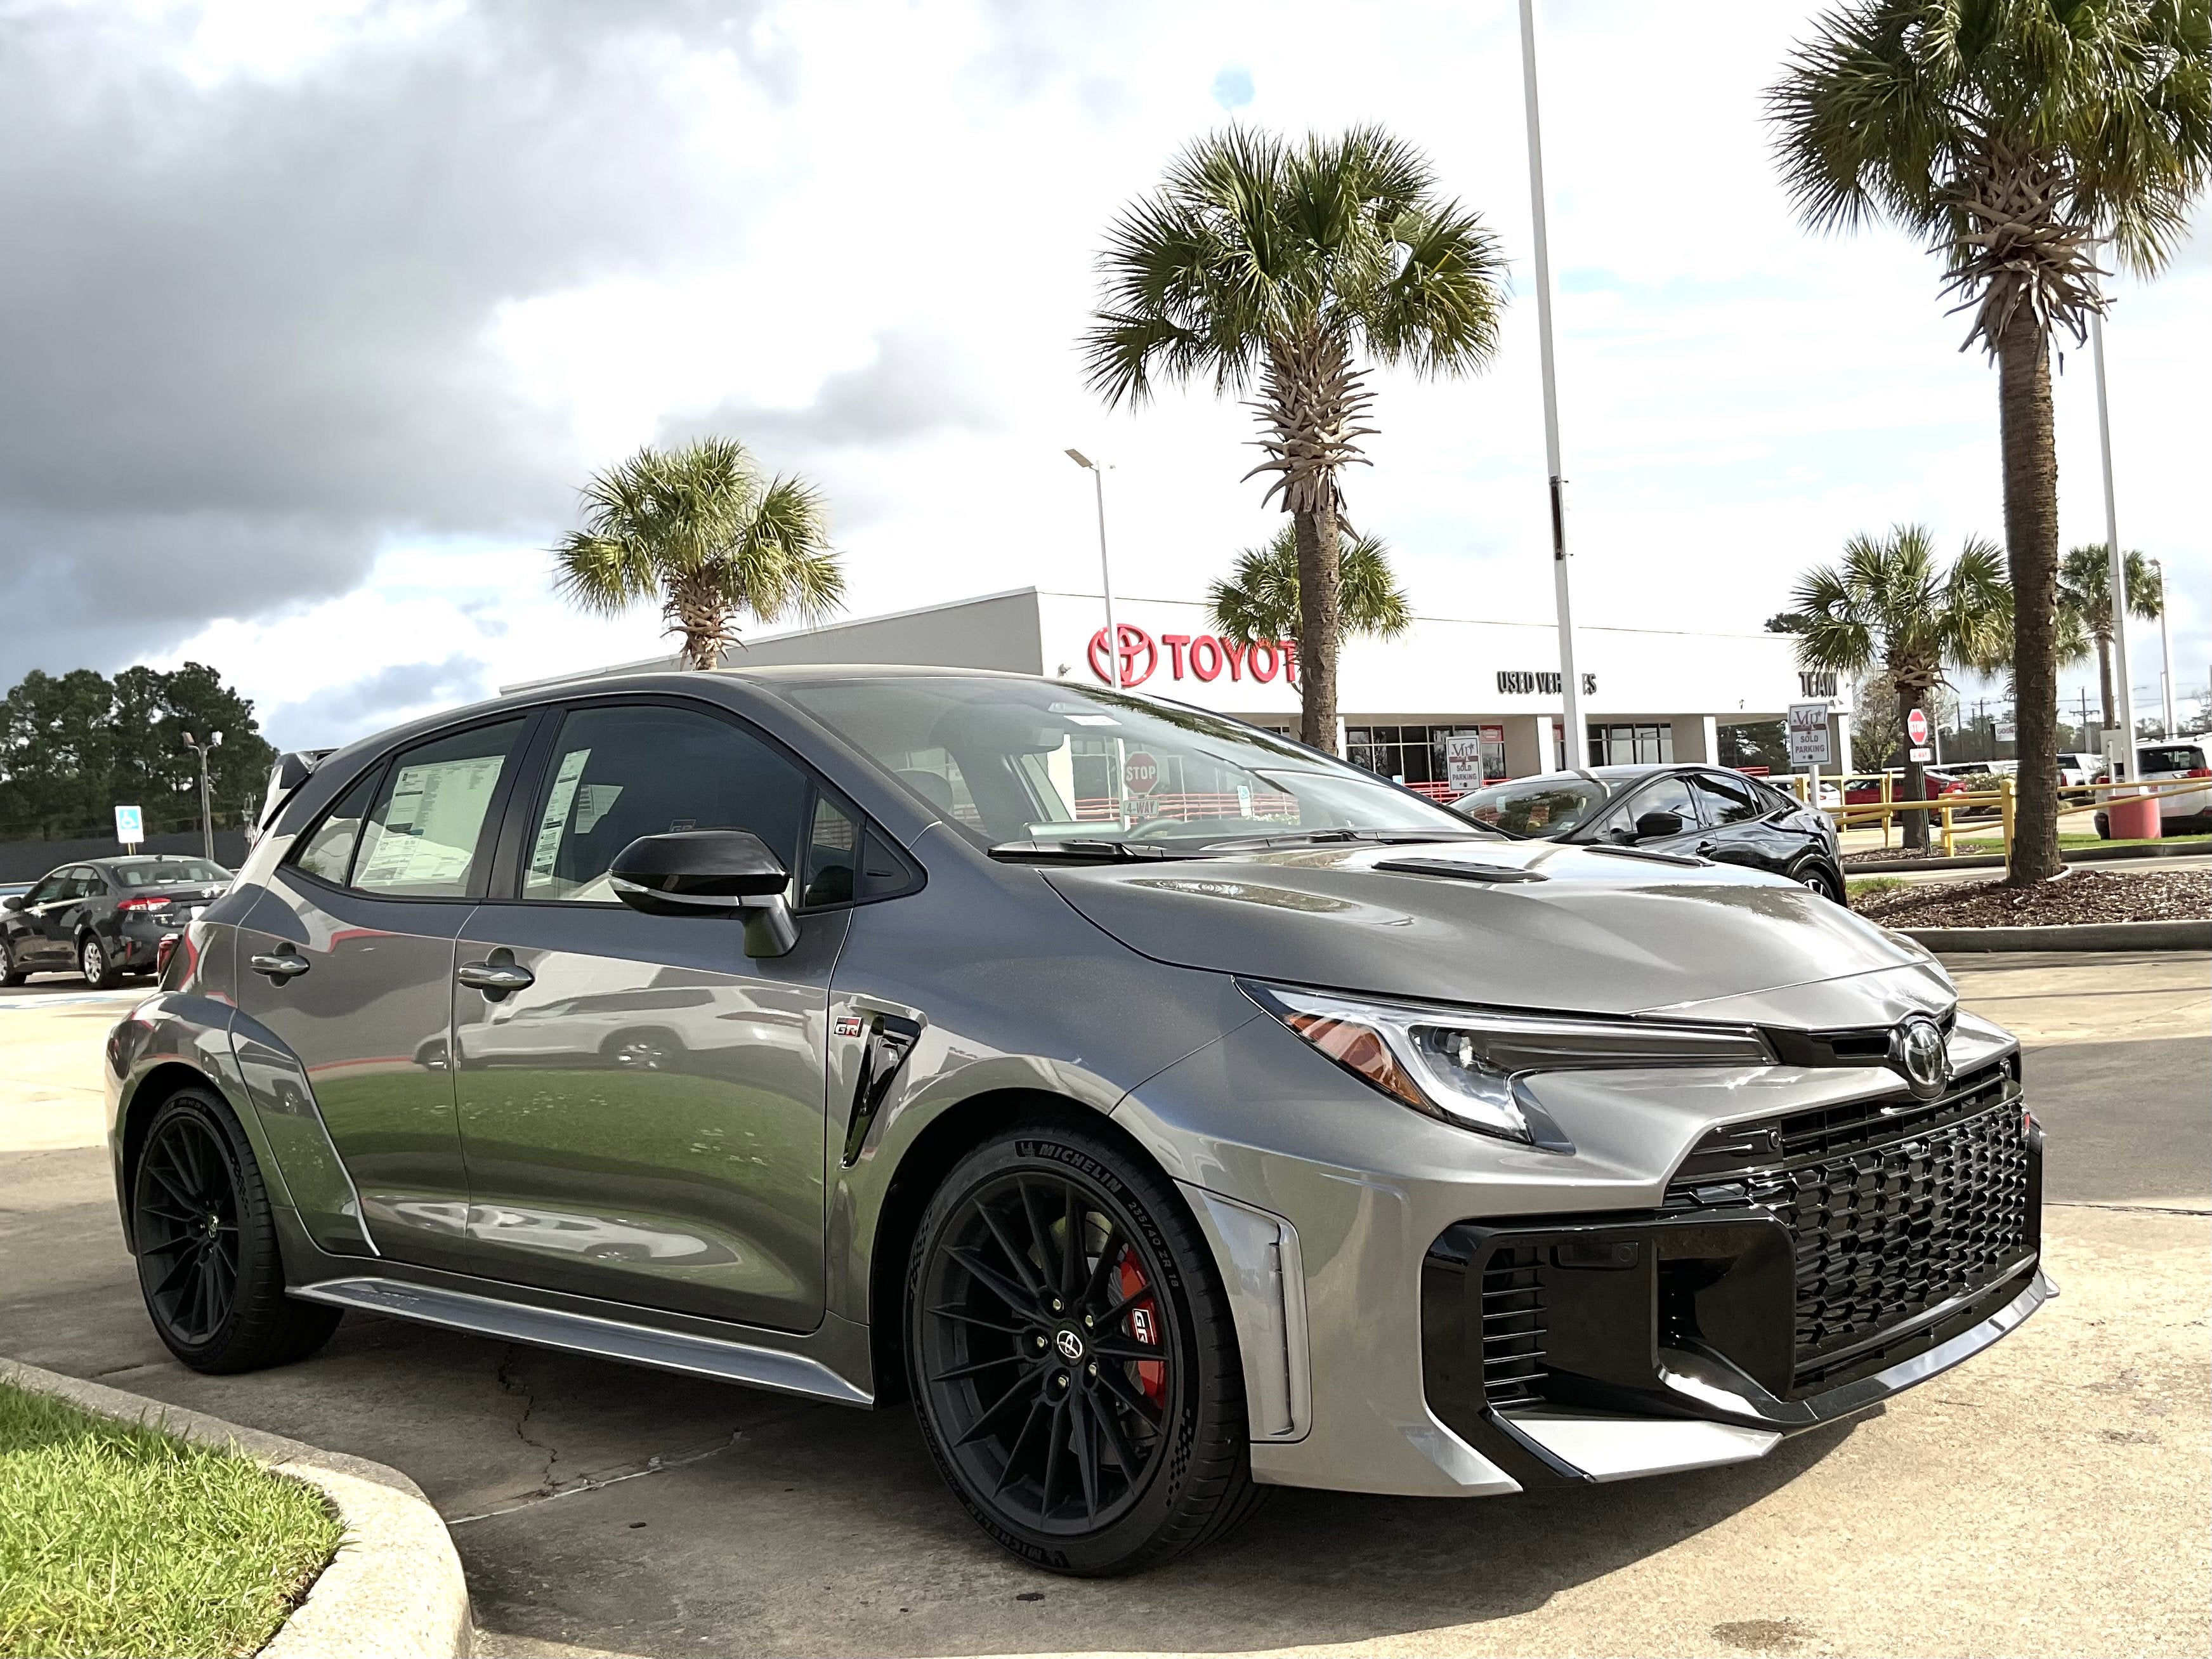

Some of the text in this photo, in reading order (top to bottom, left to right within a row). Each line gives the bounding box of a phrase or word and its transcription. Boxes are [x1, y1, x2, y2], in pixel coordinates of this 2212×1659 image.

[1162, 634, 1298, 684] TOYOT
[1496, 671, 1597, 695] USED VEHES
[1798, 671, 1838, 698] TEAM
[1909, 721, 1927, 733] STOP
[1800, 735, 1819, 743] SOLD
[1795, 745, 1825, 754] PARKING
[1125, 766, 1156, 782] STOP
[1127, 801, 1155, 814] 4-WAY
[835, 1024, 858, 1035] GR
[1038, 1144, 1179, 1287] MICHELIN 235/40 ZR 18
[1135, 1311, 1148, 1344] GR
